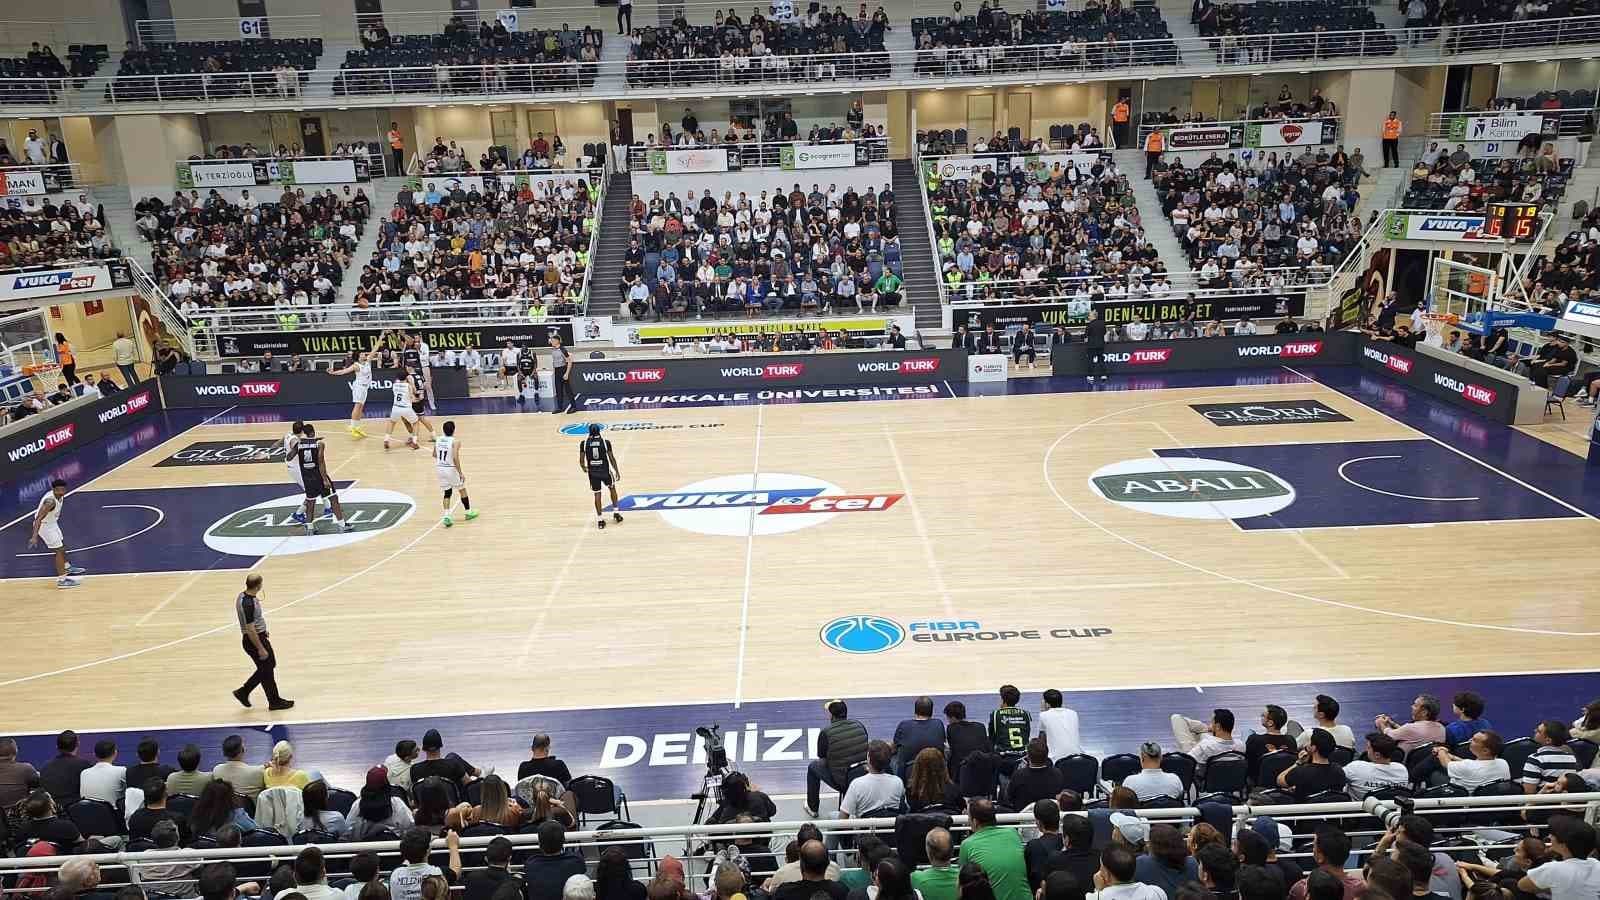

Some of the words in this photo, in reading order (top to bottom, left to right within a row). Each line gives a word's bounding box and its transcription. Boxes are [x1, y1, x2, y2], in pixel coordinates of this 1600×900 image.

[1491, 118, 1518, 128] Bilim
[1487, 143, 1499, 153] D1
[1427, 219, 1468, 230] YUKA
[1515, 219, 1531, 236] 15
[18, 275, 60, 288] YUKA
[1161, 303, 1212, 321] BASET
[302, 335, 366, 352] YUKATEL
[429, 332, 482, 349] BASKET
[1134, 351, 1167, 362] TURK
[1238, 345, 1282, 357] WORLD
[1285, 343, 1318, 354] TURK
[857, 361, 900, 372] WORLD
[903, 359, 936, 370] TURK
[1364, 346, 1388, 364] WORLD
[1389, 356, 1409, 373] TURK
[582, 371, 626, 382] WORLD
[628, 370, 662, 381] TURK
[720, 366, 763, 377] WORLD
[766, 365, 799, 376] TURK
[195, 385, 240, 395] WORLD
[242, 383, 277, 394] TURK
[583, 392, 750, 406] PAMUKKALE
[757, 384, 939, 399] ÜNİVERSİTESİ
[1434, 372, 1465, 393] WORLD
[1467, 385, 1492, 404] TURK
[98, 404, 128, 424] WORLD
[127, 393, 149, 411] TURK
[1203, 405, 1338, 420] GLORIA
[8, 439, 46, 462] WORLD
[46, 428, 73, 446] TURK
[438, 450, 449, 461] 11
[1122, 476, 1265, 494] ABALI
[631, 491, 769, 508] YUKA
[809, 495, 887, 511] tel
[909, 620, 981, 632] FIBA
[912, 629, 1042, 643] EUROPE
[1050, 627, 1113, 638] CUP
[1008, 727, 1024, 748] 5
